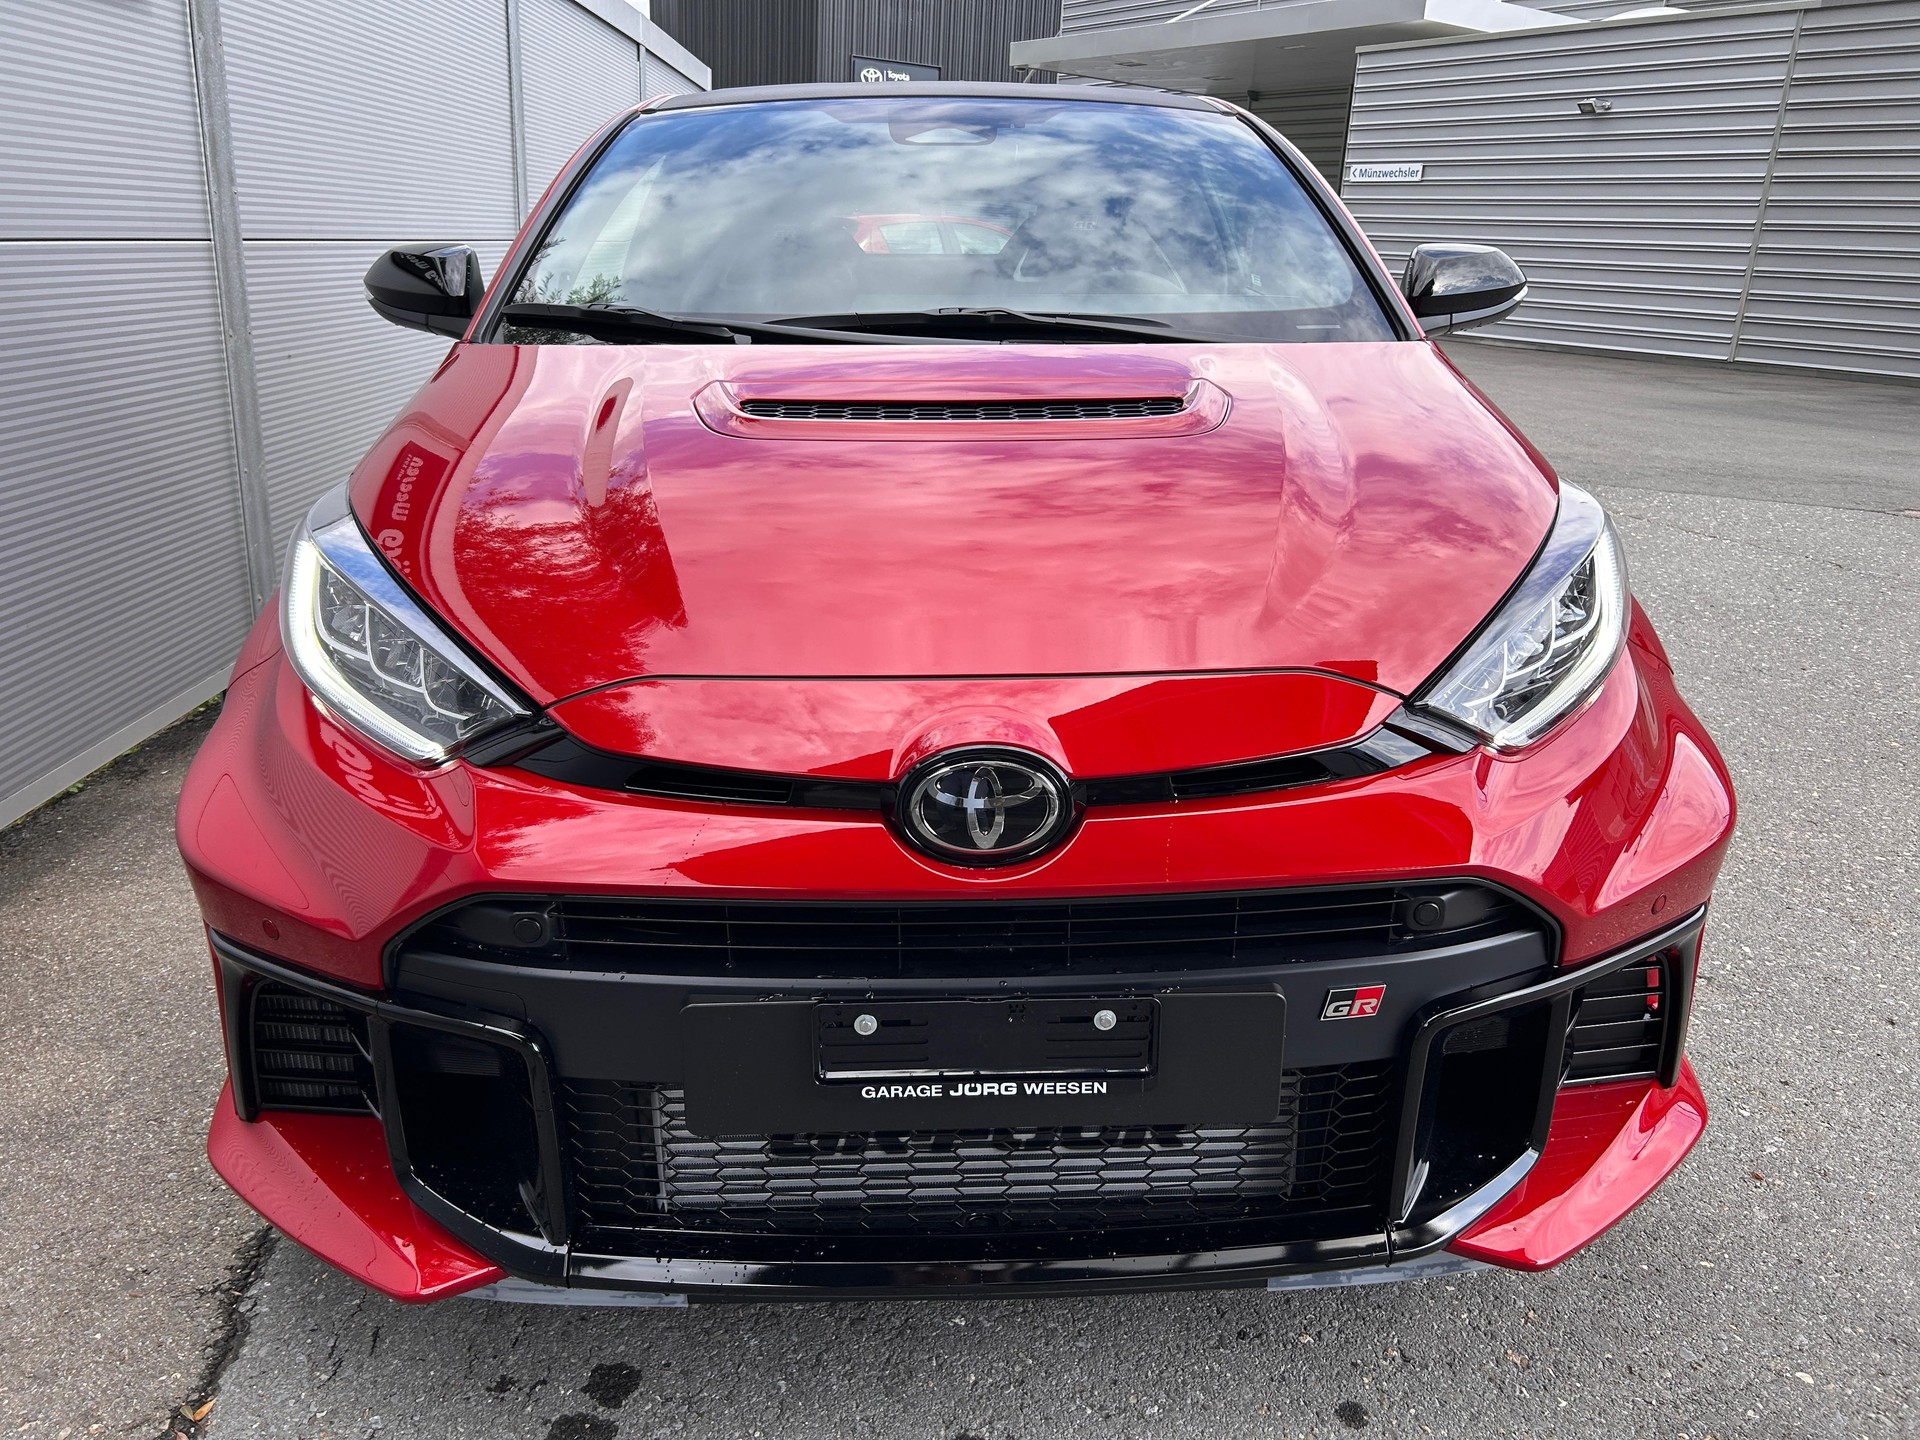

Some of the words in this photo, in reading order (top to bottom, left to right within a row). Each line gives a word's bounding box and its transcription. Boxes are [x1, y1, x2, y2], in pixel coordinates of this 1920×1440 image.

[1359, 167, 1419, 178] Münzwechsler
[1326, 998, 1377, 1017] GR
[861, 1085, 943, 1098] GARAGE
[949, 1082, 1018, 1096] JÖRG
[1023, 1081, 1107, 1095] WEESEN
